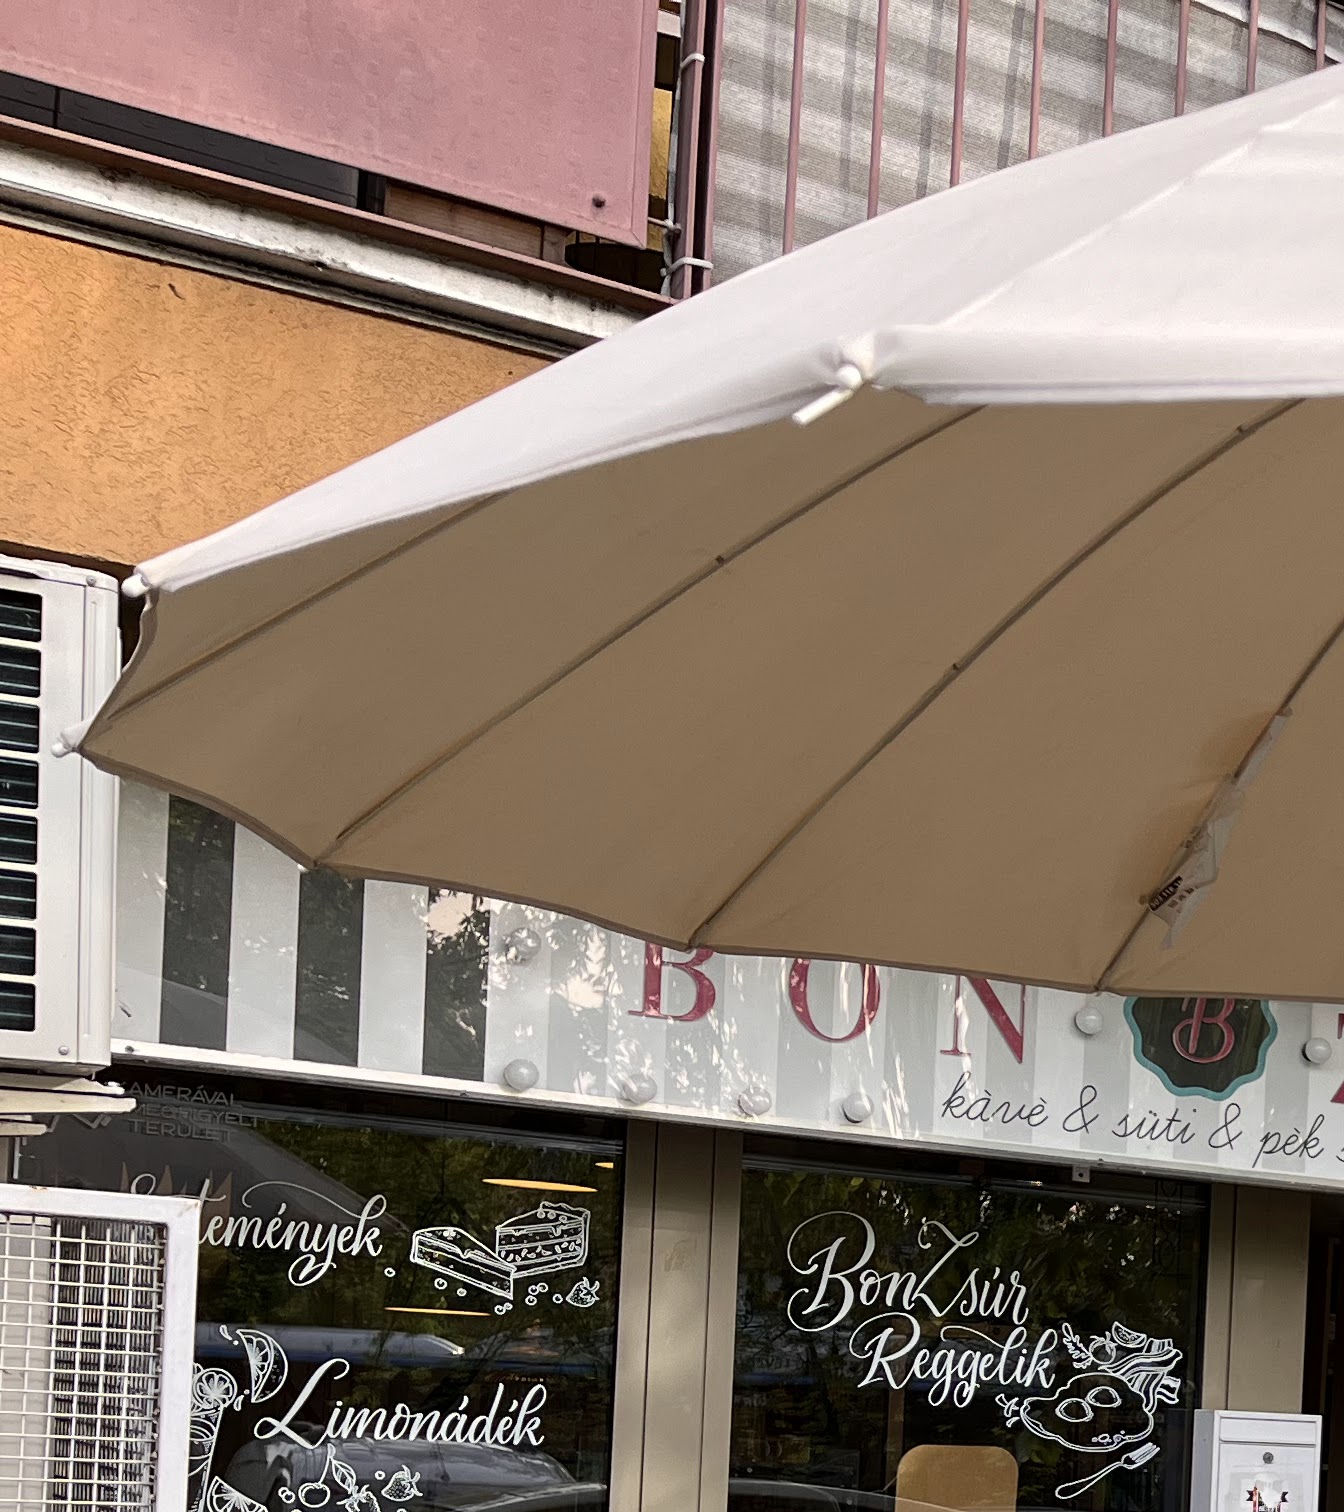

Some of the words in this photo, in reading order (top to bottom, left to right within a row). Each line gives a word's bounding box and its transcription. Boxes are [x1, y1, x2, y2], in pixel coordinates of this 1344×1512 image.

[125, 1081, 242, 1107] AMERÁVAL
[1063, 1085, 1099, 1134] &
[1112, 1108, 1196, 1144] süti
[1208, 1103, 1242, 1150] &
[849, 1312, 1058, 1408] Reggelik
[253, 1357, 548, 1450] Limonádék
